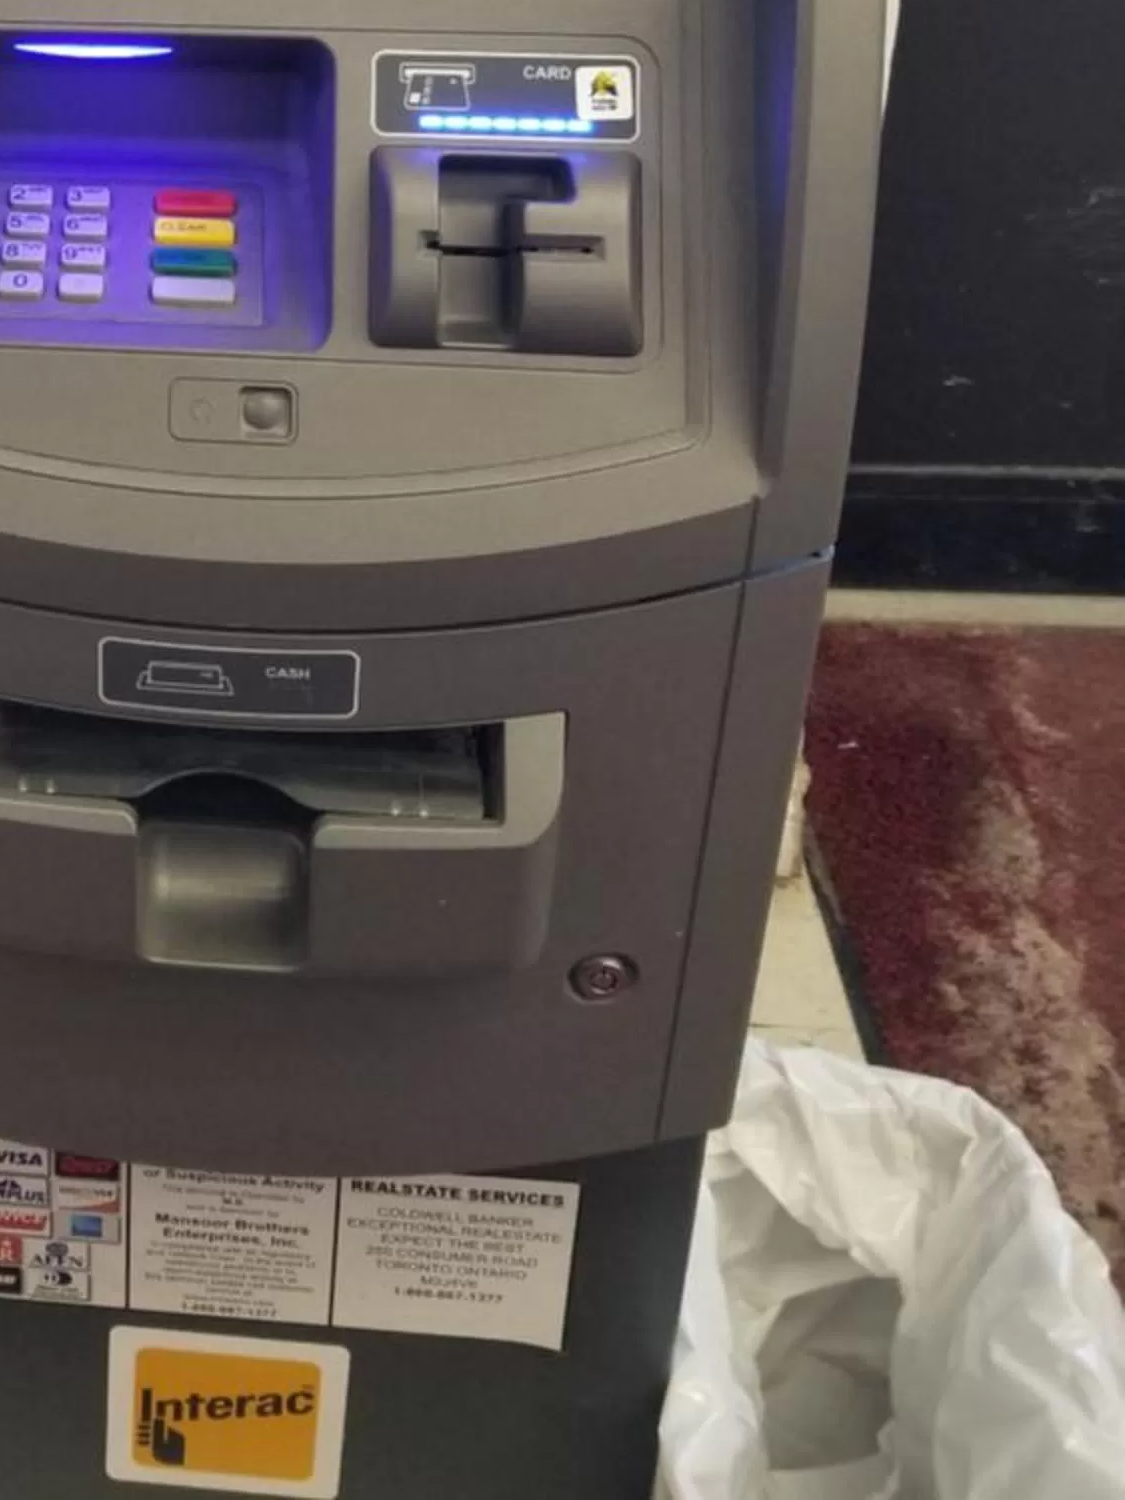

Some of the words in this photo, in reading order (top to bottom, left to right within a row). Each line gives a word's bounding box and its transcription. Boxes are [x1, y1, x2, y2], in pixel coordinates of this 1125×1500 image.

[522, 64, 572, 81] CARD
[11, 185, 26, 199] 2
[9, 214, 23, 228] 5
[66, 216, 80, 230] 6
[5, 243, 20, 258] 8
[265, 666, 311, 680] CASH
[262, 1175, 324, 1194] Activity
[350, 1179, 463, 1202] REALSTATE
[468, 1187, 566, 1208] SERVICES
[376, 1206, 461, 1224] COLDWELL
[235, 1219, 311, 1237] Brothers
[141, 1386, 316, 1422] Interac
